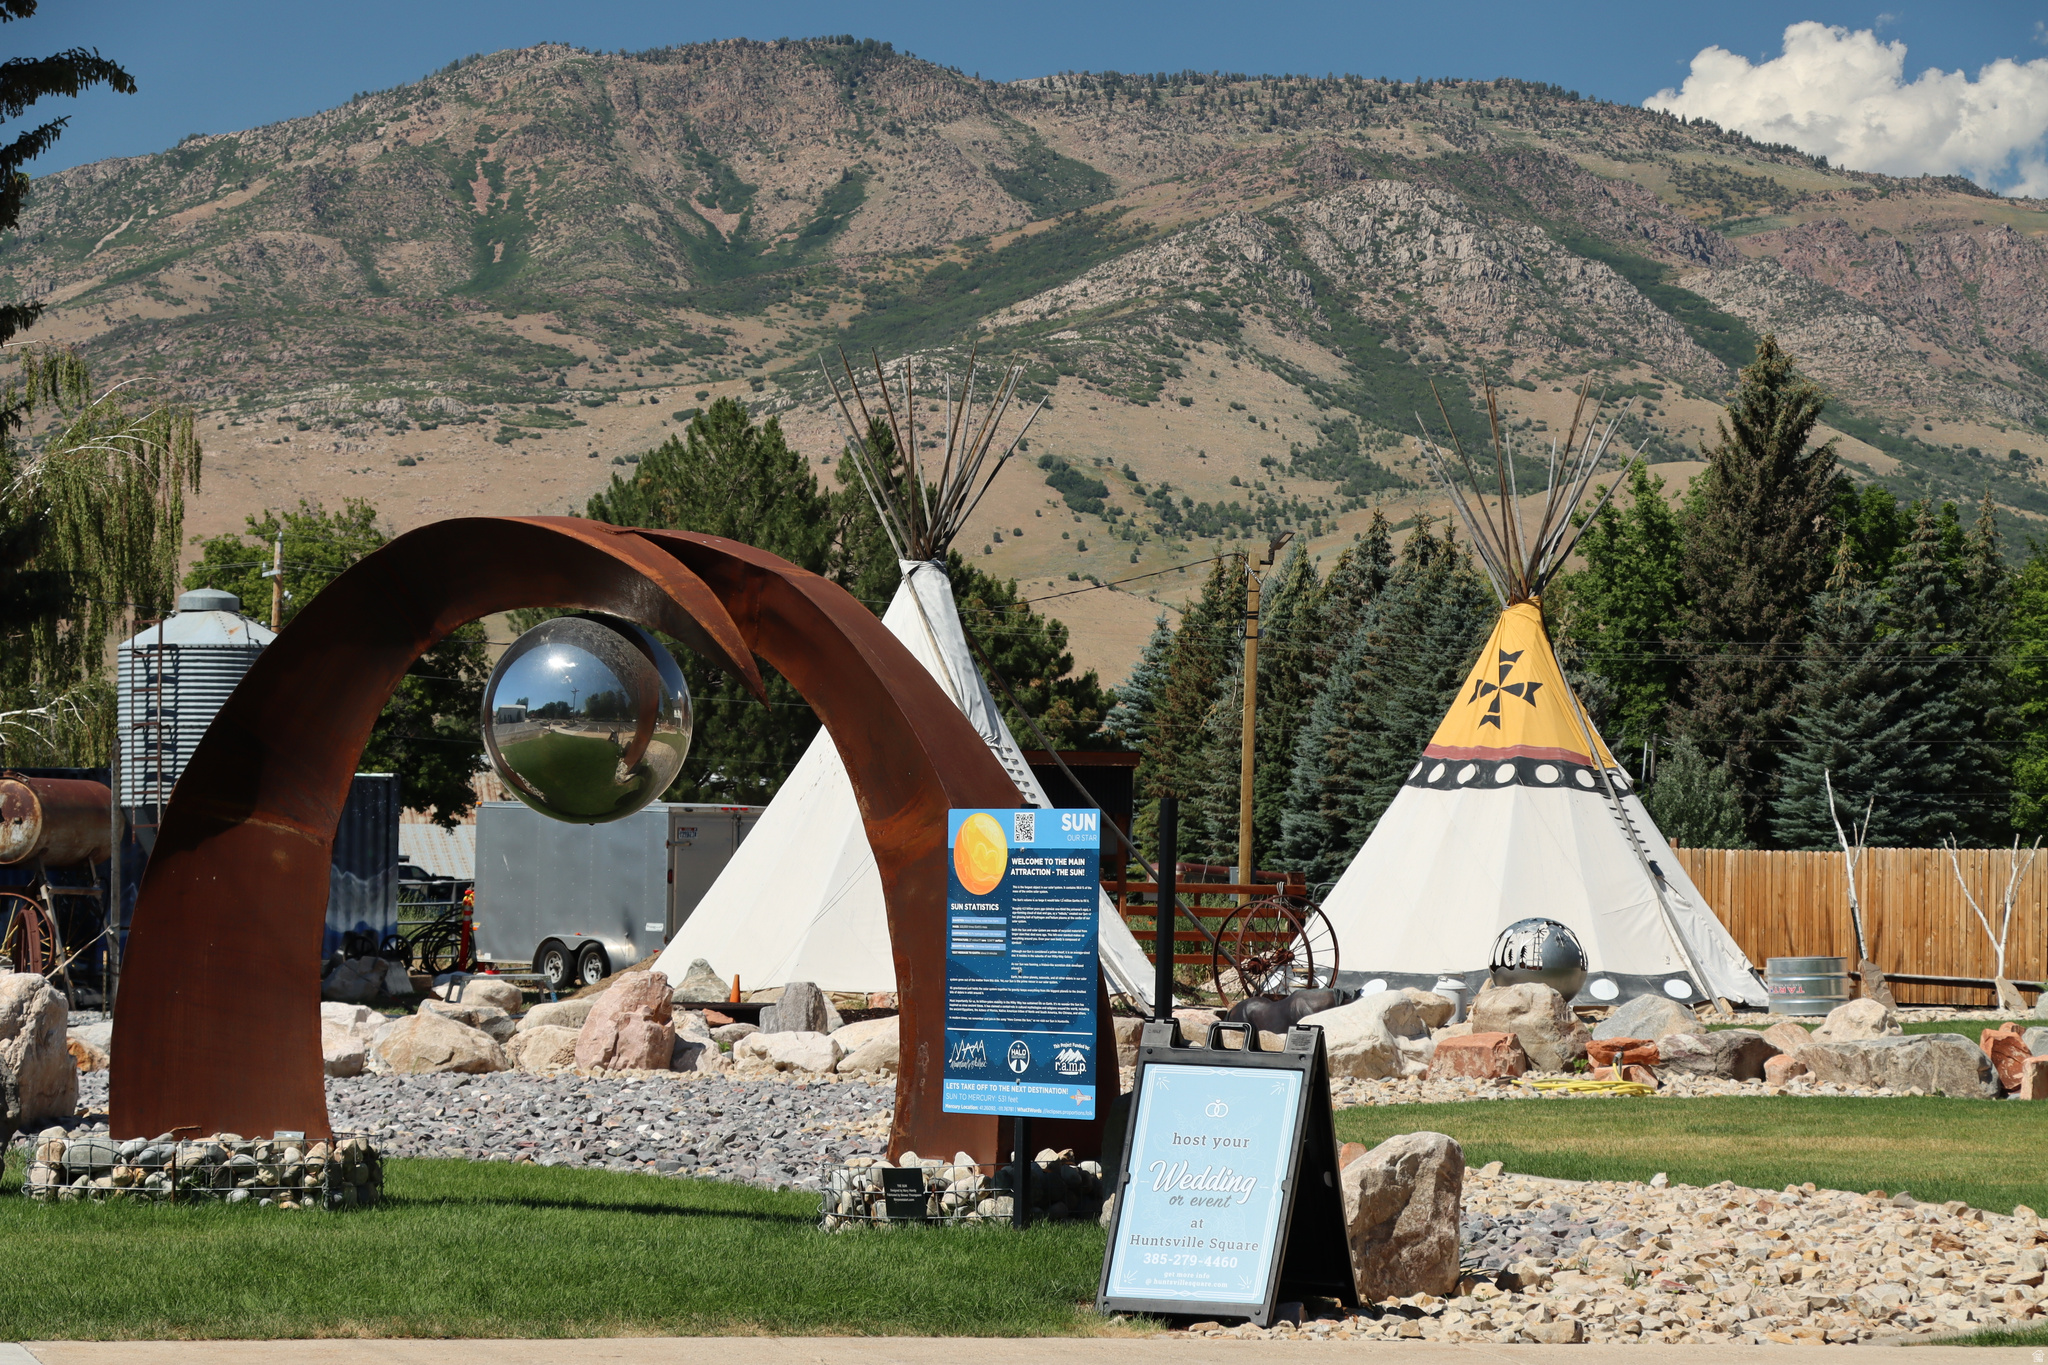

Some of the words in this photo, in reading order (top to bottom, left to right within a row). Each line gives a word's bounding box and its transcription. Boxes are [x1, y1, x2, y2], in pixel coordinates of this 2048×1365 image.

[1061, 813, 1096, 831] SUN
[1028, 1086, 1068, 1094] DESTINATION!
[1172, 1133, 1207, 1147] host
[1212, 1135, 1250, 1150] your
[1149, 1160, 1257, 1204] Wedding
[1169, 1195, 1184, 1206] or
[1190, 1194, 1232, 1208] event
[1190, 1219, 1204, 1228] at
[1130, 1235, 1204, 1248] Huntsville
[1209, 1238, 1259, 1252] Square
[1143, 1253, 1238, 1268] 385-279-4460
[1153, 1278, 1228, 1288] huntsvillesquare.com
